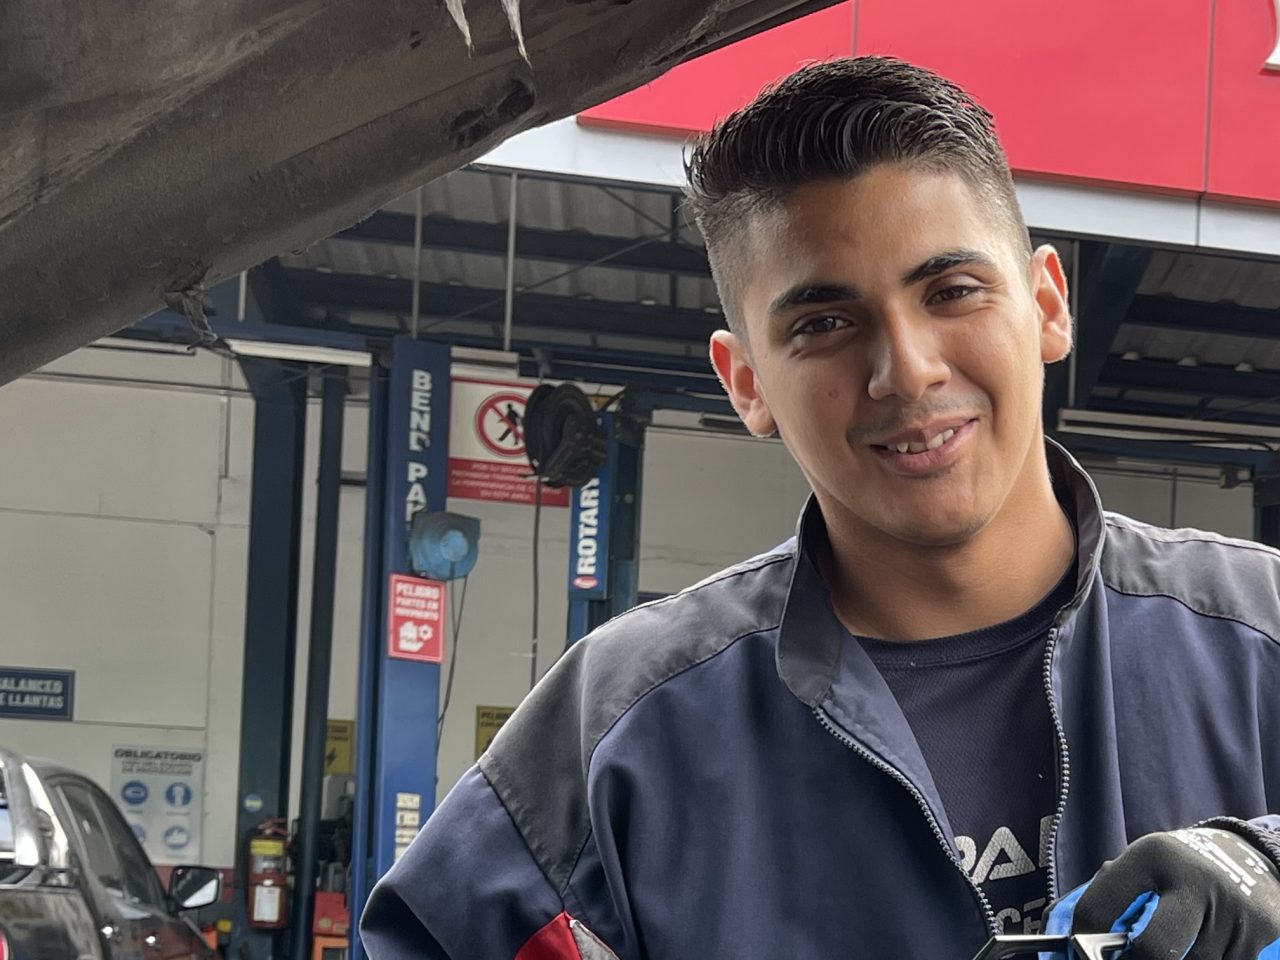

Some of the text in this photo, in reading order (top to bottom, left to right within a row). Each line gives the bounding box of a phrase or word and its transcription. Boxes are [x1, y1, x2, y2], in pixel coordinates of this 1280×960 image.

[396, 582, 440, 600] PELIGRO
[0, 677, 63, 694] ALANCEO
[8, 693, 64, 710] LLANTAS
[114, 748, 202, 762] OBLIGATORIO
